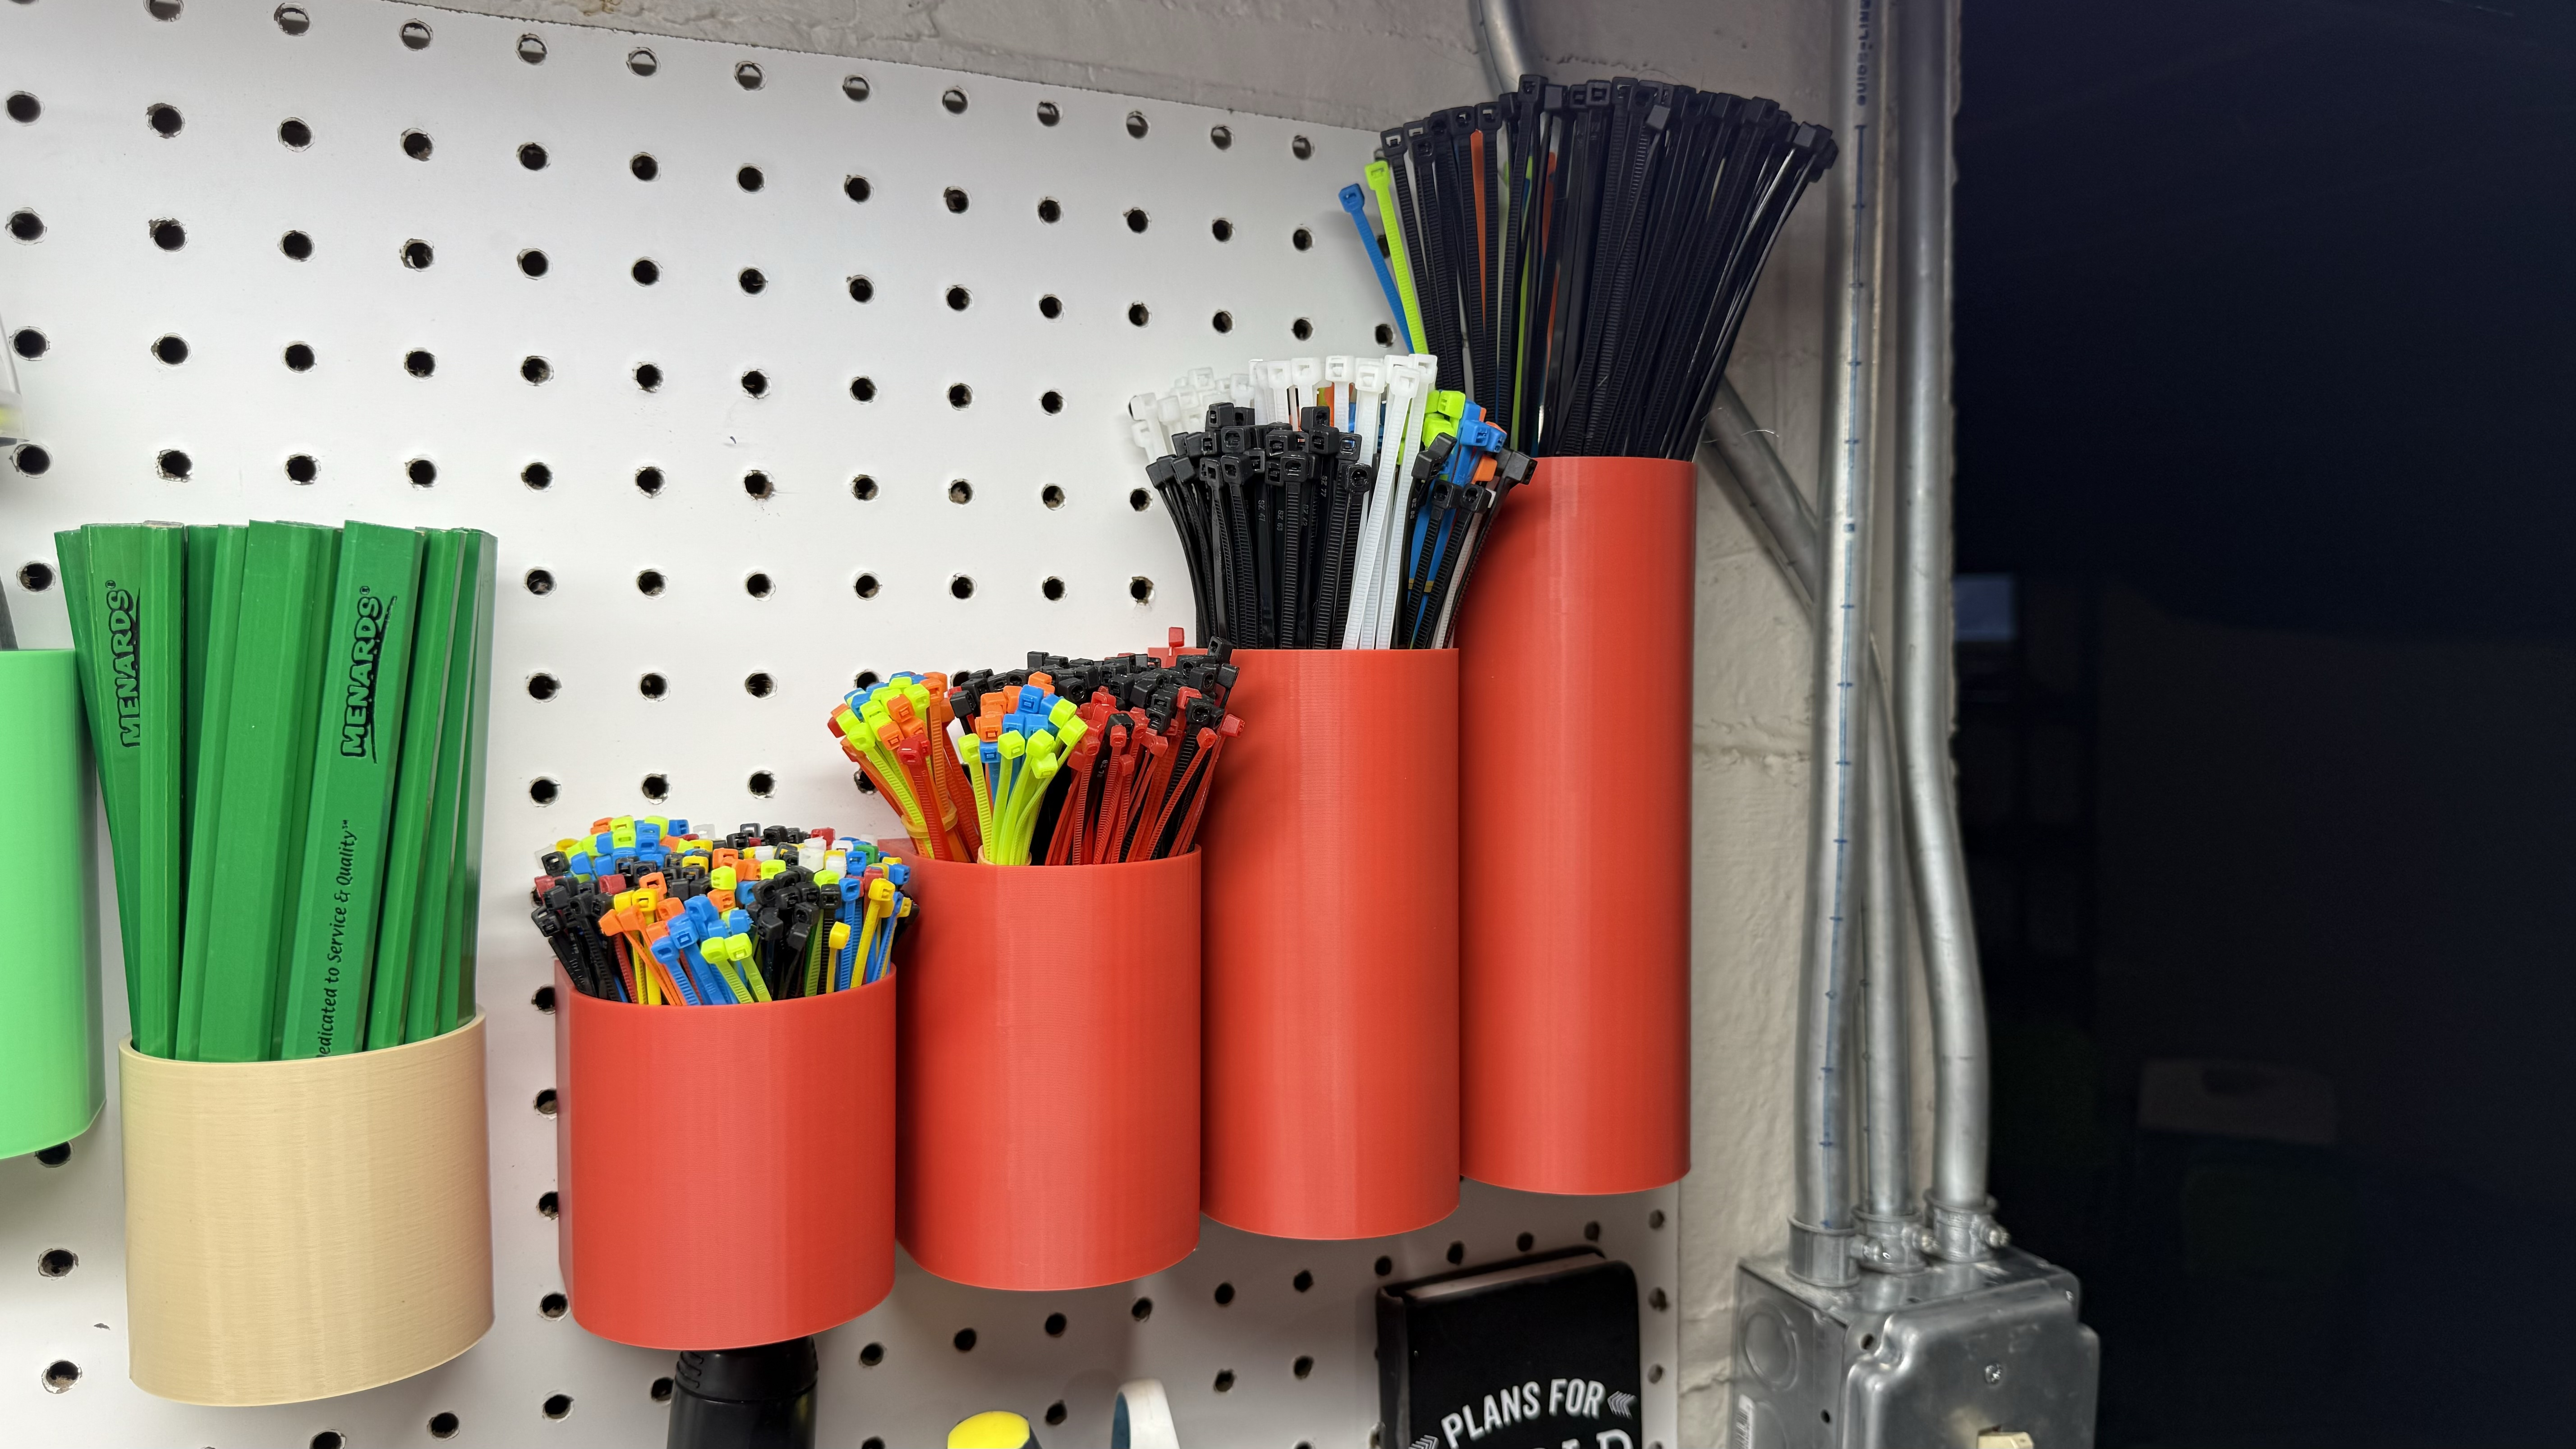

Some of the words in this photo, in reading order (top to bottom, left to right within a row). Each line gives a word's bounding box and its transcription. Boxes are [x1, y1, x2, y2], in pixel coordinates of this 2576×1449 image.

[1321, 475, 1328, 486] SZ
[1320, 488, 1327, 497] 77
[1258, 500, 1265, 511] SZ
[1277, 510, 1284, 520] SZ
[333, 889, 351, 903] &
[327, 906, 348, 963] Service
[324, 967, 340, 984] to
[315, 988, 338, 1058] edicated
[1441, 1381, 1541, 1449] PLANS
[1549, 1378, 1606, 1420] FOR
